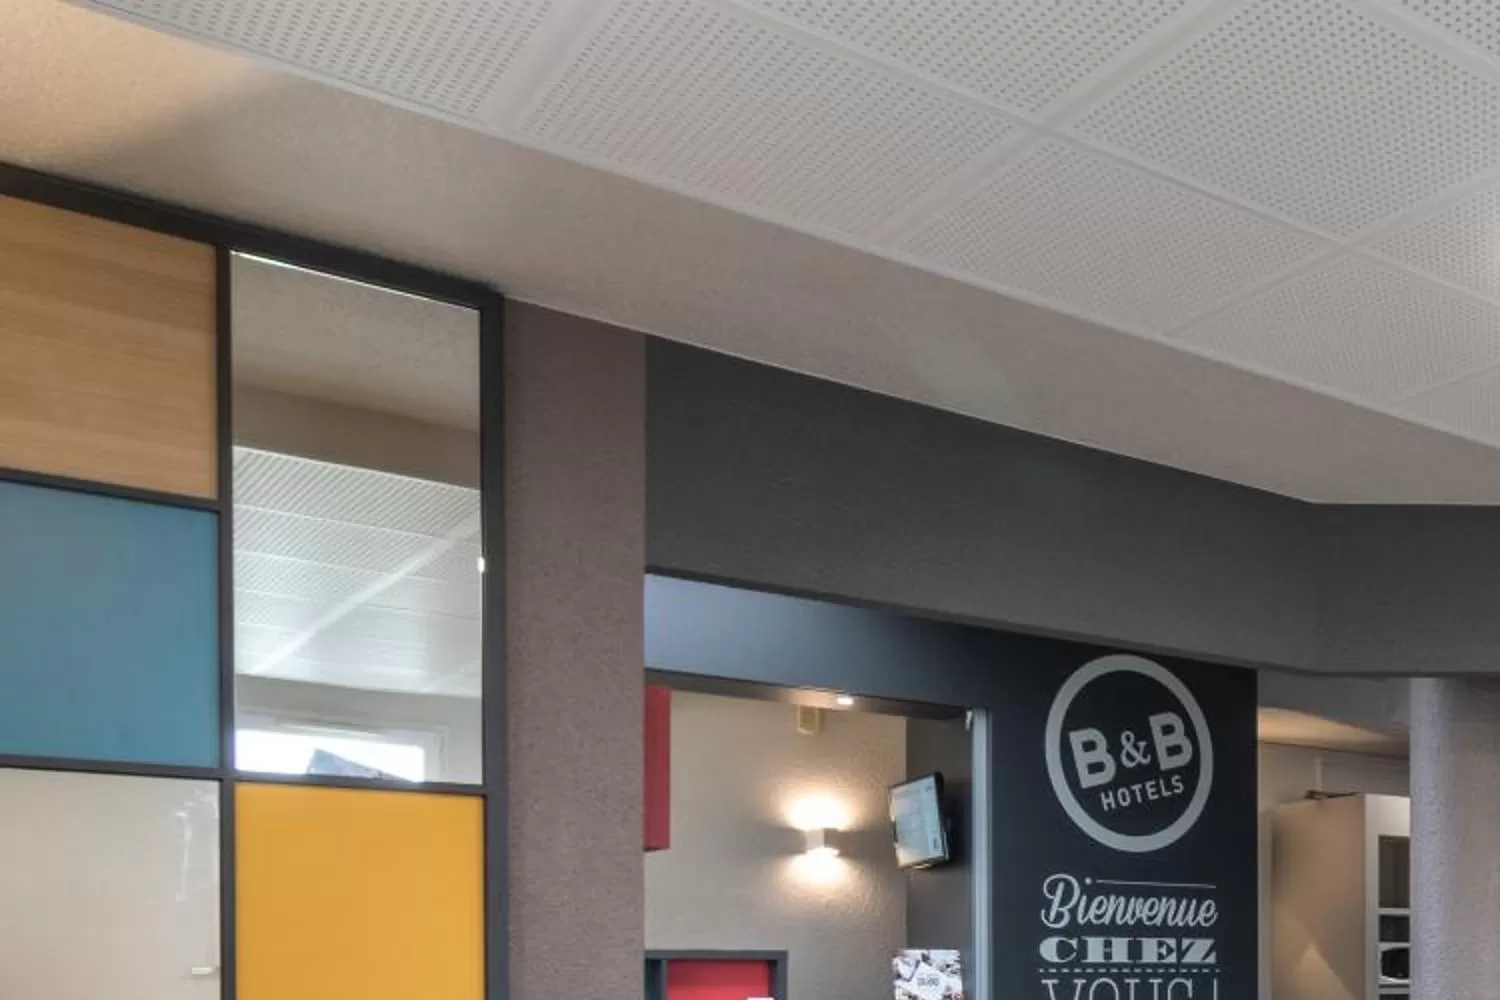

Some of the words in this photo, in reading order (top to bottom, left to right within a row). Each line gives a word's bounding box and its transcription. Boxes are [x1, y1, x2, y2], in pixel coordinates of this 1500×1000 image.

[1068, 711, 1193, 789] B&B
[1101, 775, 1185, 812] HOTELS
[1040, 873, 1219, 929] Bienvenue
[1039, 936, 1217, 965] CHEZ
